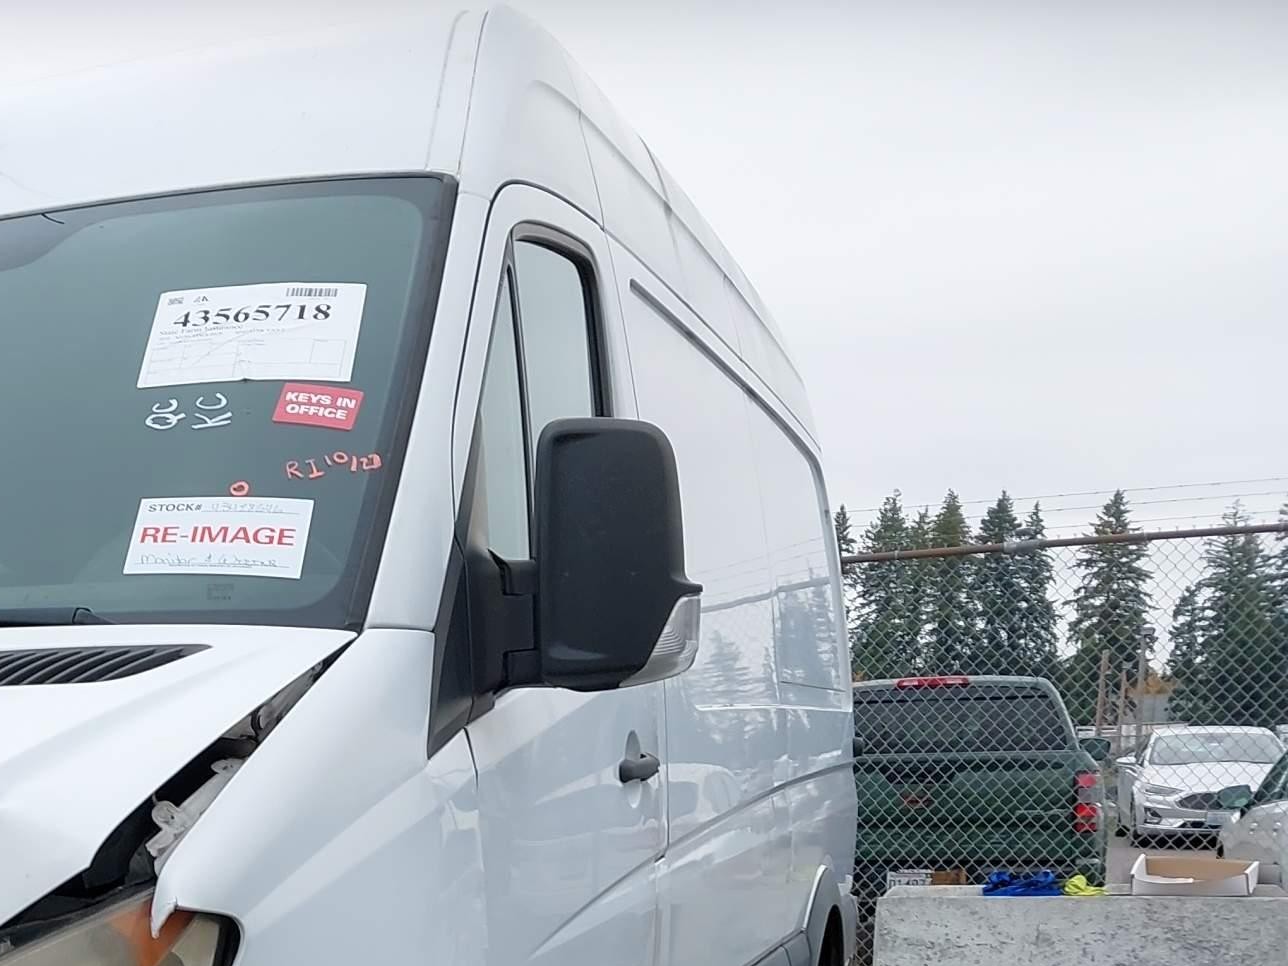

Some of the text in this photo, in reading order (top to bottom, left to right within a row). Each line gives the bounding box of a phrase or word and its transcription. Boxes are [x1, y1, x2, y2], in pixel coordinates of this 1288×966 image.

[172, 303, 333, 328] 43565718
[285, 391, 357, 409] KEYS IN
[285, 403, 348, 420] OFFICE
[147, 502, 203, 513] STOCK#
[139, 525, 297, 547] RE-IMAGE
